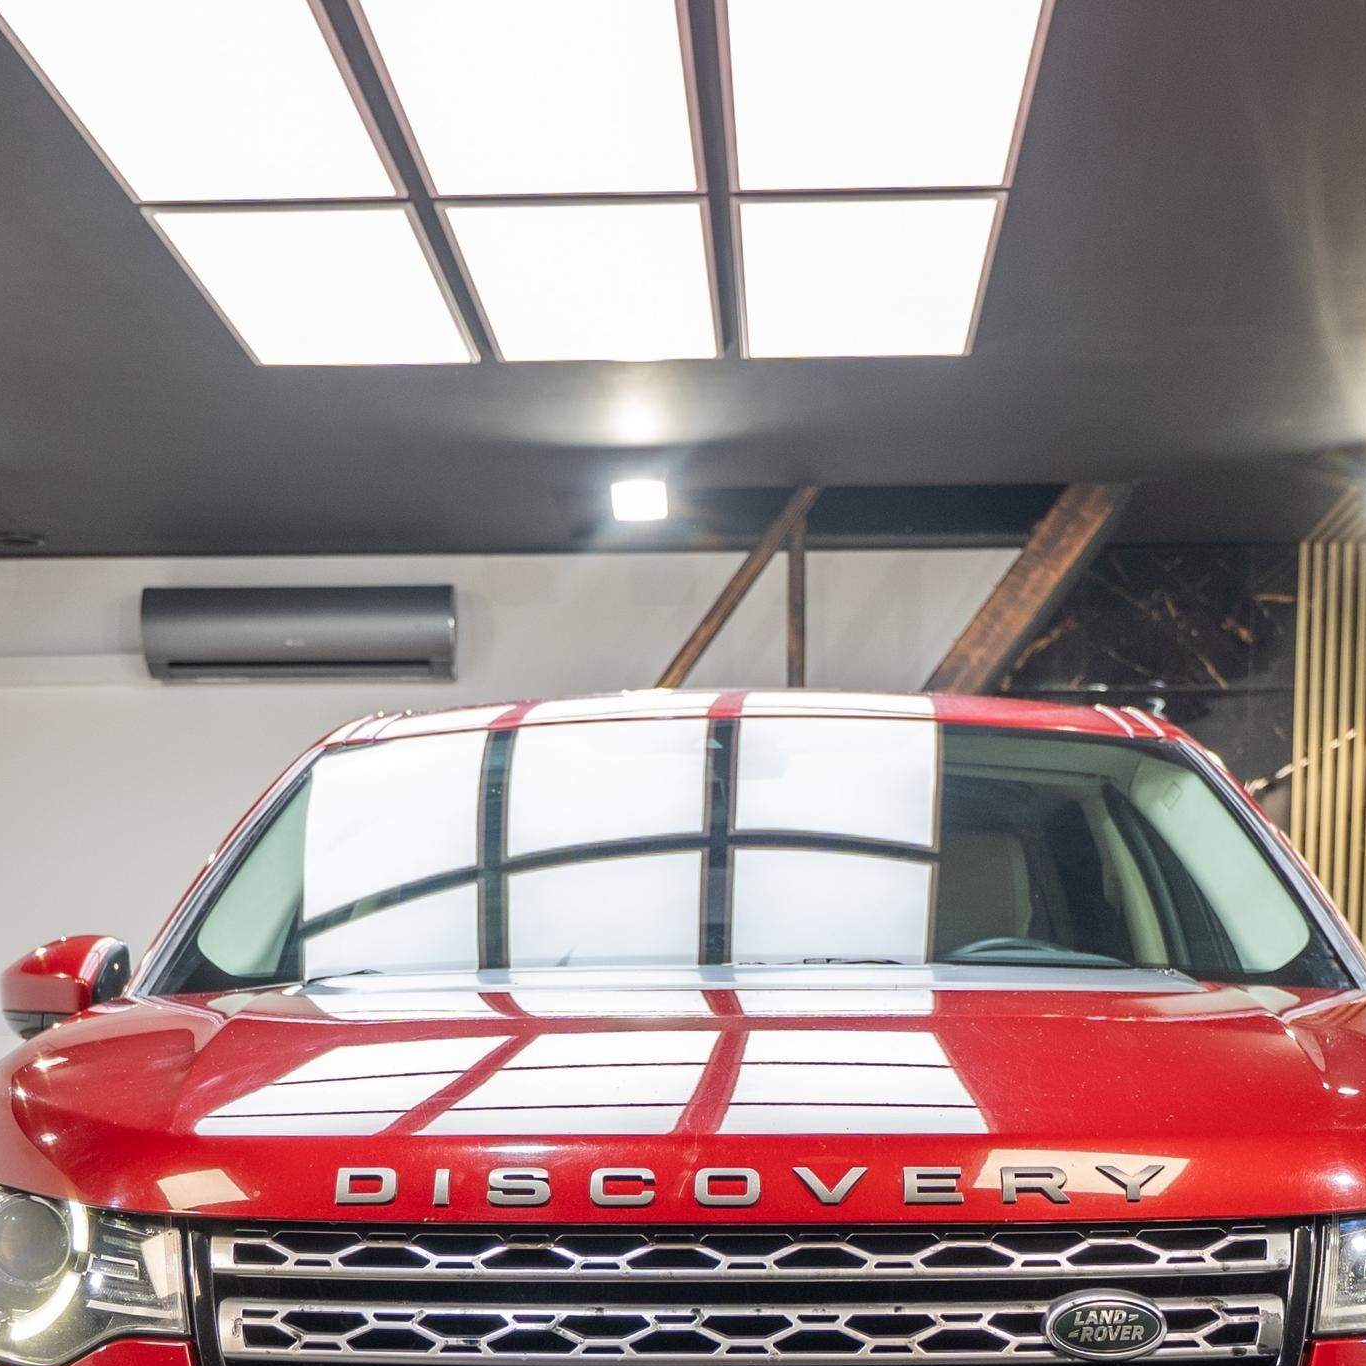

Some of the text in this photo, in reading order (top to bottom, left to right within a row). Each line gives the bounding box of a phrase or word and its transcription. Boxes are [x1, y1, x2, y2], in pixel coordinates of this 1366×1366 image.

[334, 1165, 1166, 1206] DISCOVERY
[1074, 1310, 1127, 1326] LAND
[1079, 1325, 1145, 1342] ROVER
